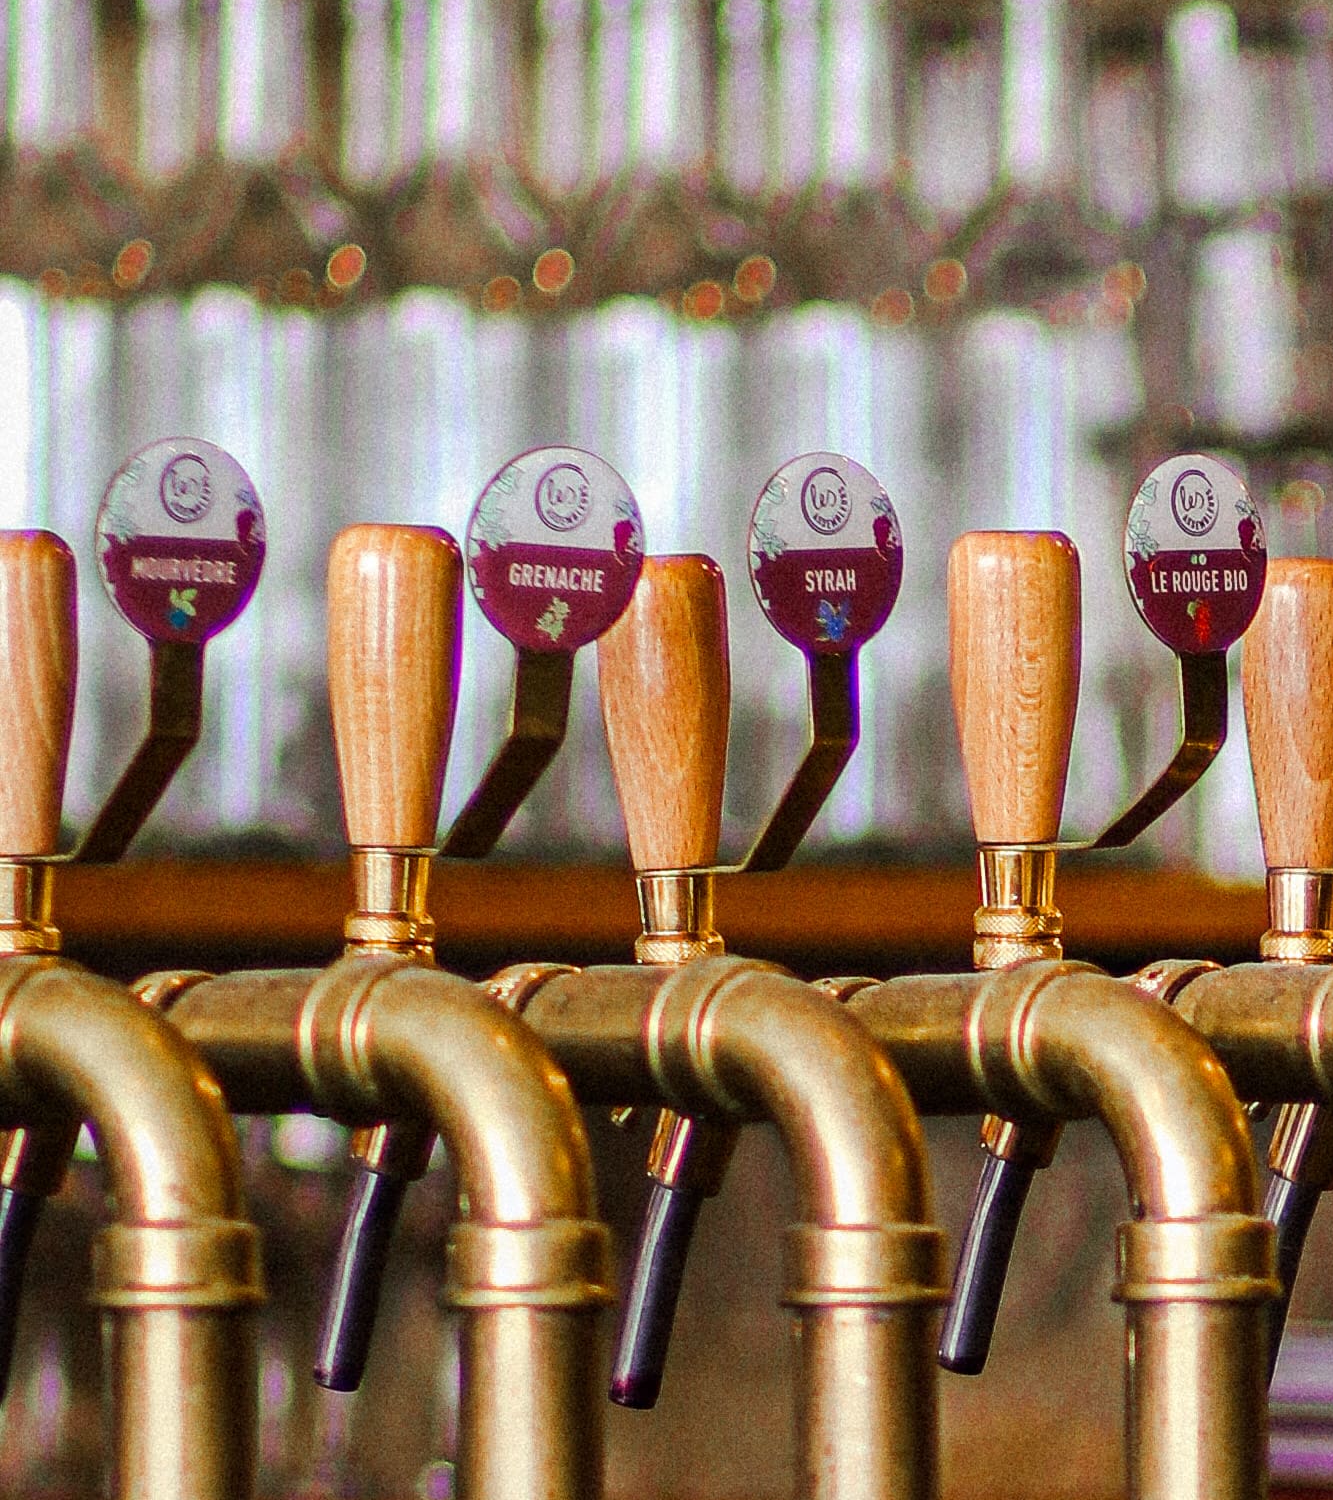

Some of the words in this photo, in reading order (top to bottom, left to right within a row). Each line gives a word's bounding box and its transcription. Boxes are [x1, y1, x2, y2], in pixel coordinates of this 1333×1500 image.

[810, 483, 837, 510] les
[1180, 485, 1205, 512] les
[508, 562, 605, 593] GRENACHE
[804, 568, 857, 593] SYRAH
[1151, 571, 1168, 593] LE
[1172, 570, 1220, 593] ROUGE
[1223, 569, 1248, 592] BIO
